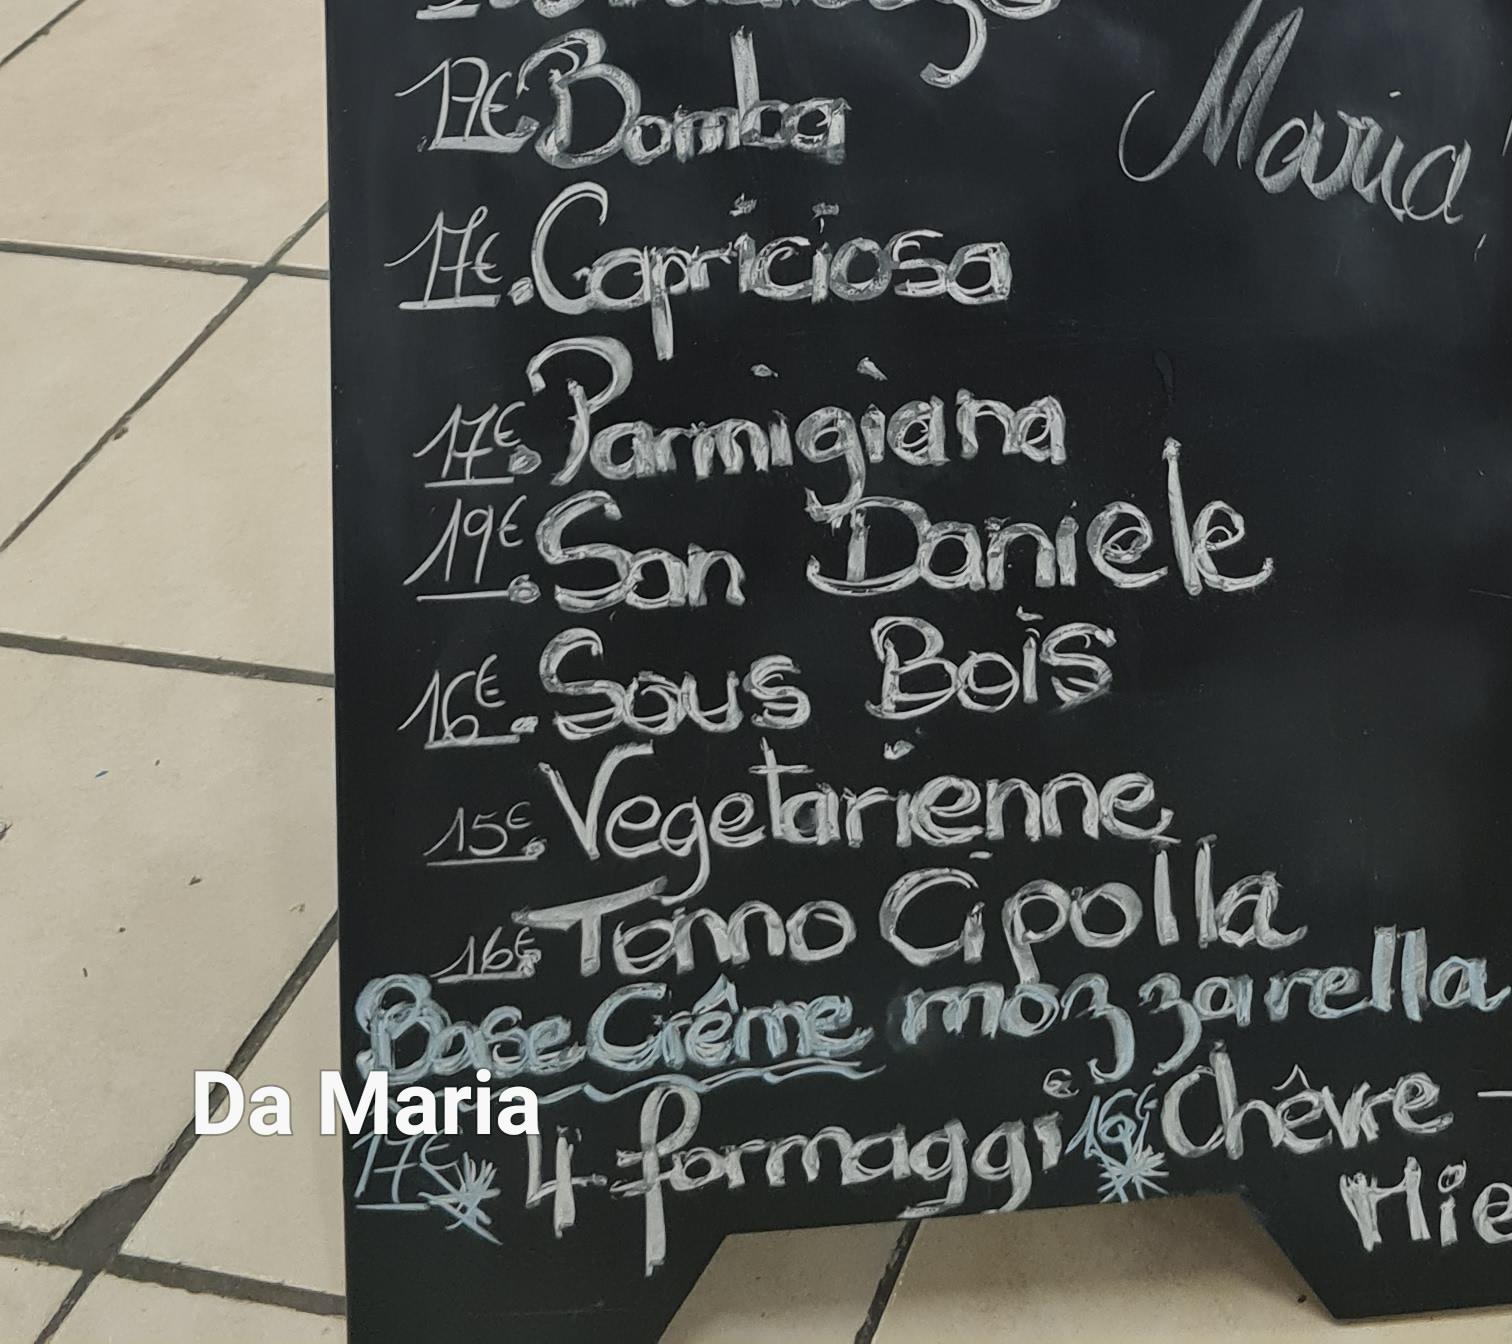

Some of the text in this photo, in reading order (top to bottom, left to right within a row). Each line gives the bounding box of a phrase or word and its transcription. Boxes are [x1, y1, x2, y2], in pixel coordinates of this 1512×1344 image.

[517, 25, 852, 170] Bomba
[530, 181, 1014, 361] Capriciosa
[526, 335, 1067, 525] Parmigiana
[535, 489, 746, 613] San
[805, 435, 1275, 597] Daniele
[539, 626, 811, 739] Sous
[866, 605, 1117, 719] Bois
[879, 834, 1307, 986] Cipolla
[355, 972, 587, 1085] Base
[901, 924, 1512, 1085] mozzarella
[610, 1068, 1080, 1277] formaggi
